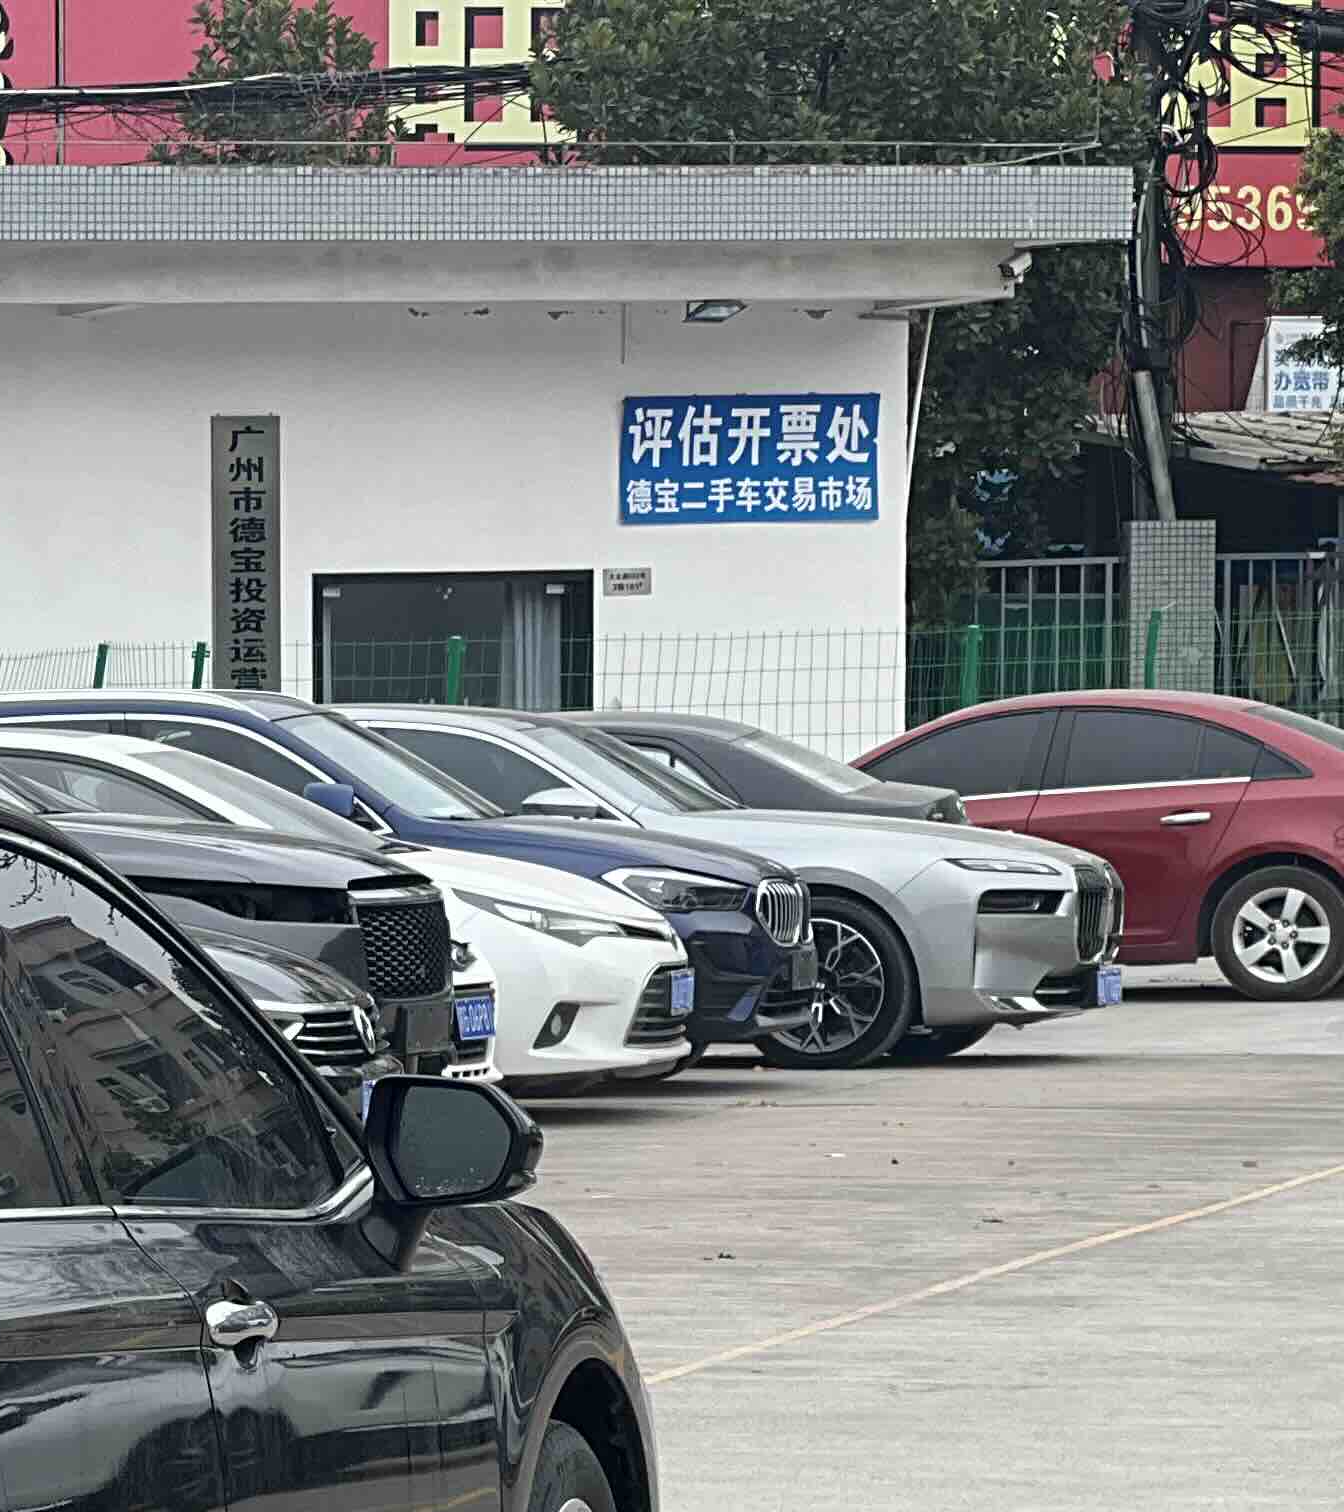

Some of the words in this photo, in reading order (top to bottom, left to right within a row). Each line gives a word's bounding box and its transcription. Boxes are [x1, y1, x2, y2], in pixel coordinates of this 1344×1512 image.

[1273, 370, 1329, 392] 办宽带
[628, 404, 871, 467] 评估开票处
[626, 475, 873, 514] 德宝二手车交易市场
[228, 425, 267, 690] 广州市德宝投资运营
